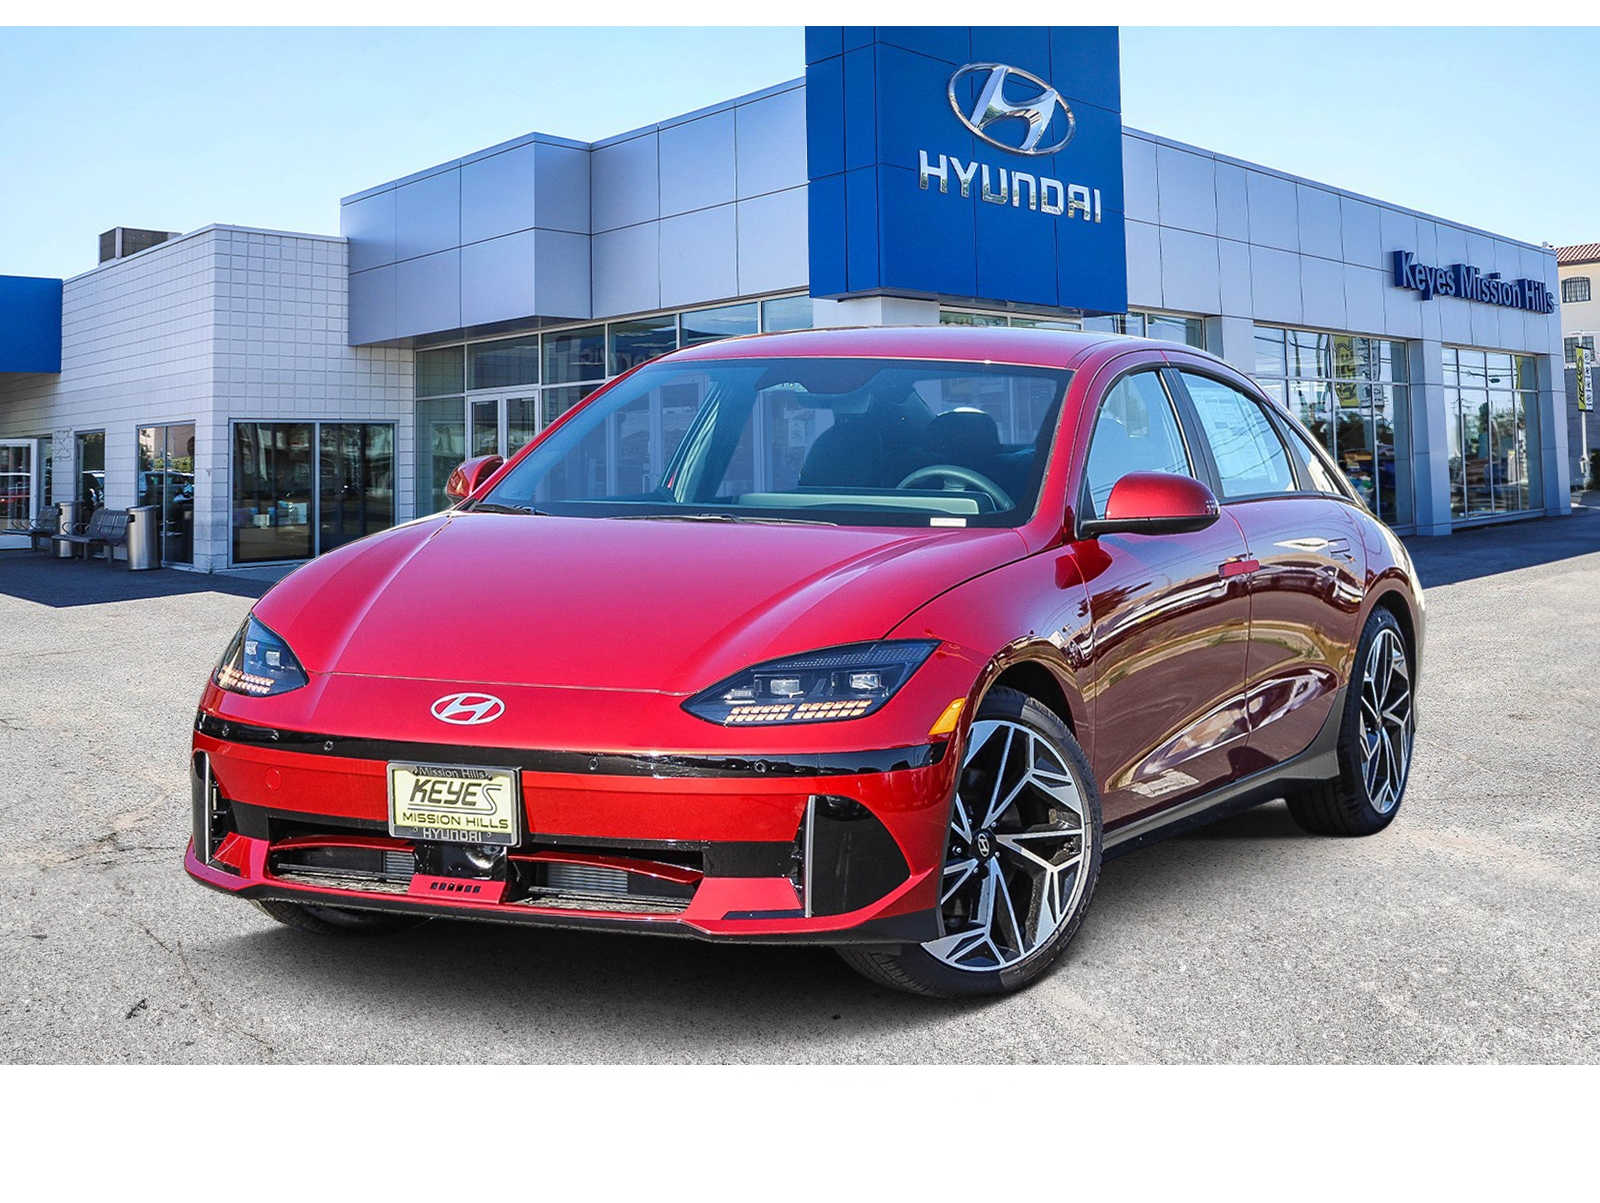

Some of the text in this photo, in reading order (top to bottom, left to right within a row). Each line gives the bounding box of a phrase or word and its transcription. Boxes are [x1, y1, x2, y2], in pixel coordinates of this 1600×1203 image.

[919, 149, 1102, 224] HYUNDAI
[1394, 250, 1555, 314] Keyes Mission Hills
[419, 766, 485, 780] Mission Hills
[408, 778, 503, 815] KEYES
[402, 812, 509, 829] MISSION HILLS
[423, 827, 482, 842] HYUNDAI
